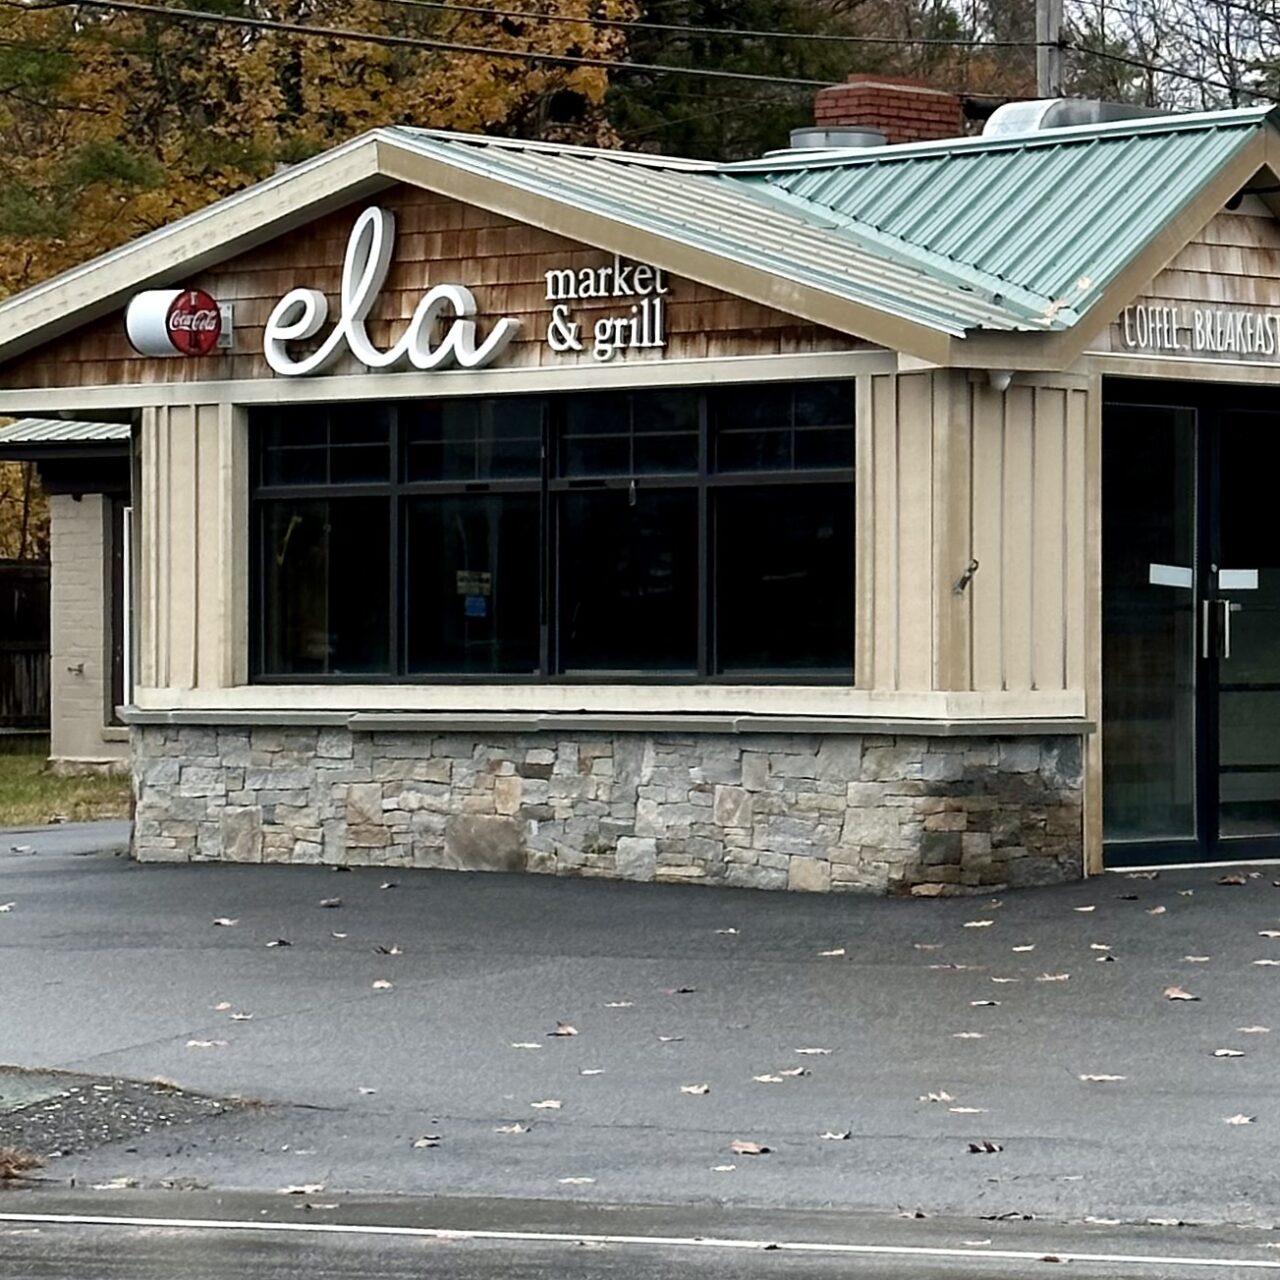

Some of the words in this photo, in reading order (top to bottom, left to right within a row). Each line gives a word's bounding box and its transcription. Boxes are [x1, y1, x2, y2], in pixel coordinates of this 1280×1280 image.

[264, 206, 519, 375] ela
[545, 254, 668, 300] market
[547, 304, 583, 351] &
[593, 297, 667, 361] grill
